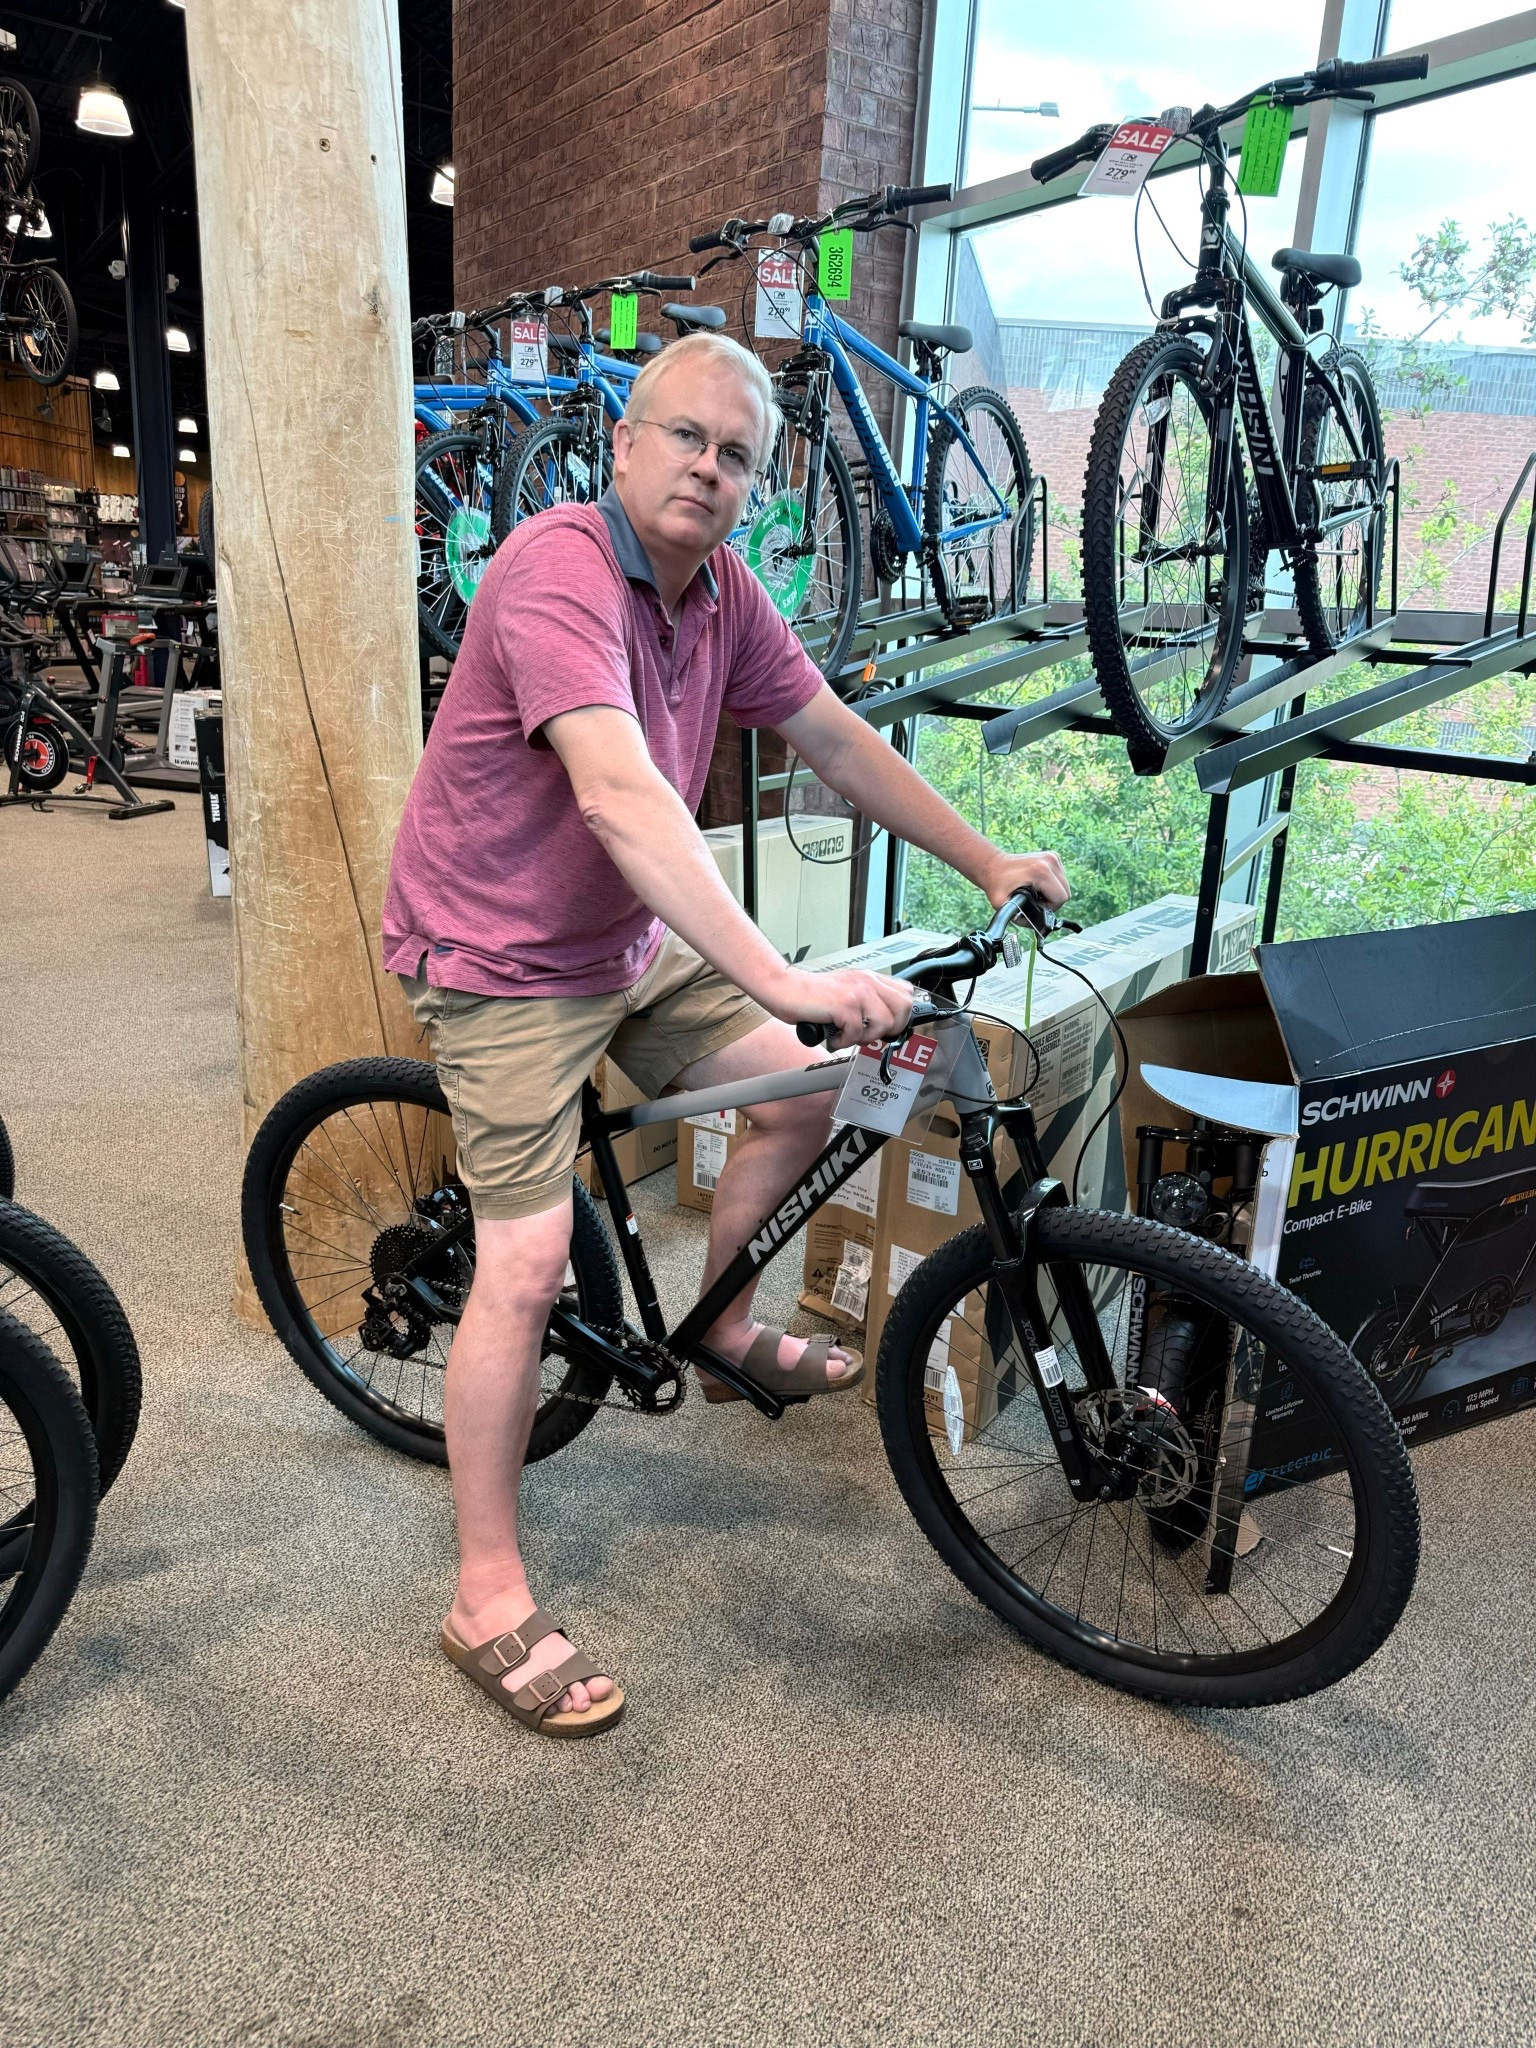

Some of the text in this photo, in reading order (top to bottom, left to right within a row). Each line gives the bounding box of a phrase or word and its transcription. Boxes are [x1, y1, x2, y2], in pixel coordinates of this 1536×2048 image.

[1113, 129, 1168, 150] SALE
[1105, 167, 1129, 178] 279
[761, 268, 800, 284] SALE
[827, 246, 844, 288] 362694
[768, 307, 785, 316] 279
[514, 327, 546, 340] SALE
[853, 387, 902, 488] NISHIKI
[210, 793, 221, 823] THULE
[1063, 924, 1160, 967] NISHIKI
[860, 1085, 889, 1103] 629
[1301, 1077, 1433, 1126] SCHWINN
[1287, 1099, 1536, 1209] HURRICAN
[747, 1127, 868, 1266] NISHIKI
[1283, 1199, 1373, 1235] Compact E-Bike
[1288, 1269, 1322, 1285] Twist Throttle
[1430, 1303, 1459, 1325] SCHWINN
[1126, 1277, 1147, 1384] SCHWINN
[1478, 1387, 1495, 1399] MPH
[1265, 1398, 1304, 1417] Limited Lifetime
[1271, 1408, 1296, 1421] Warranty
[1465, 1403, 1479, 1413] Max
[1401, 1416, 1411, 1426] 30
[1411, 1411, 1429, 1422] Miles
[1272, 1447, 1333, 1478] ELECTRIC
